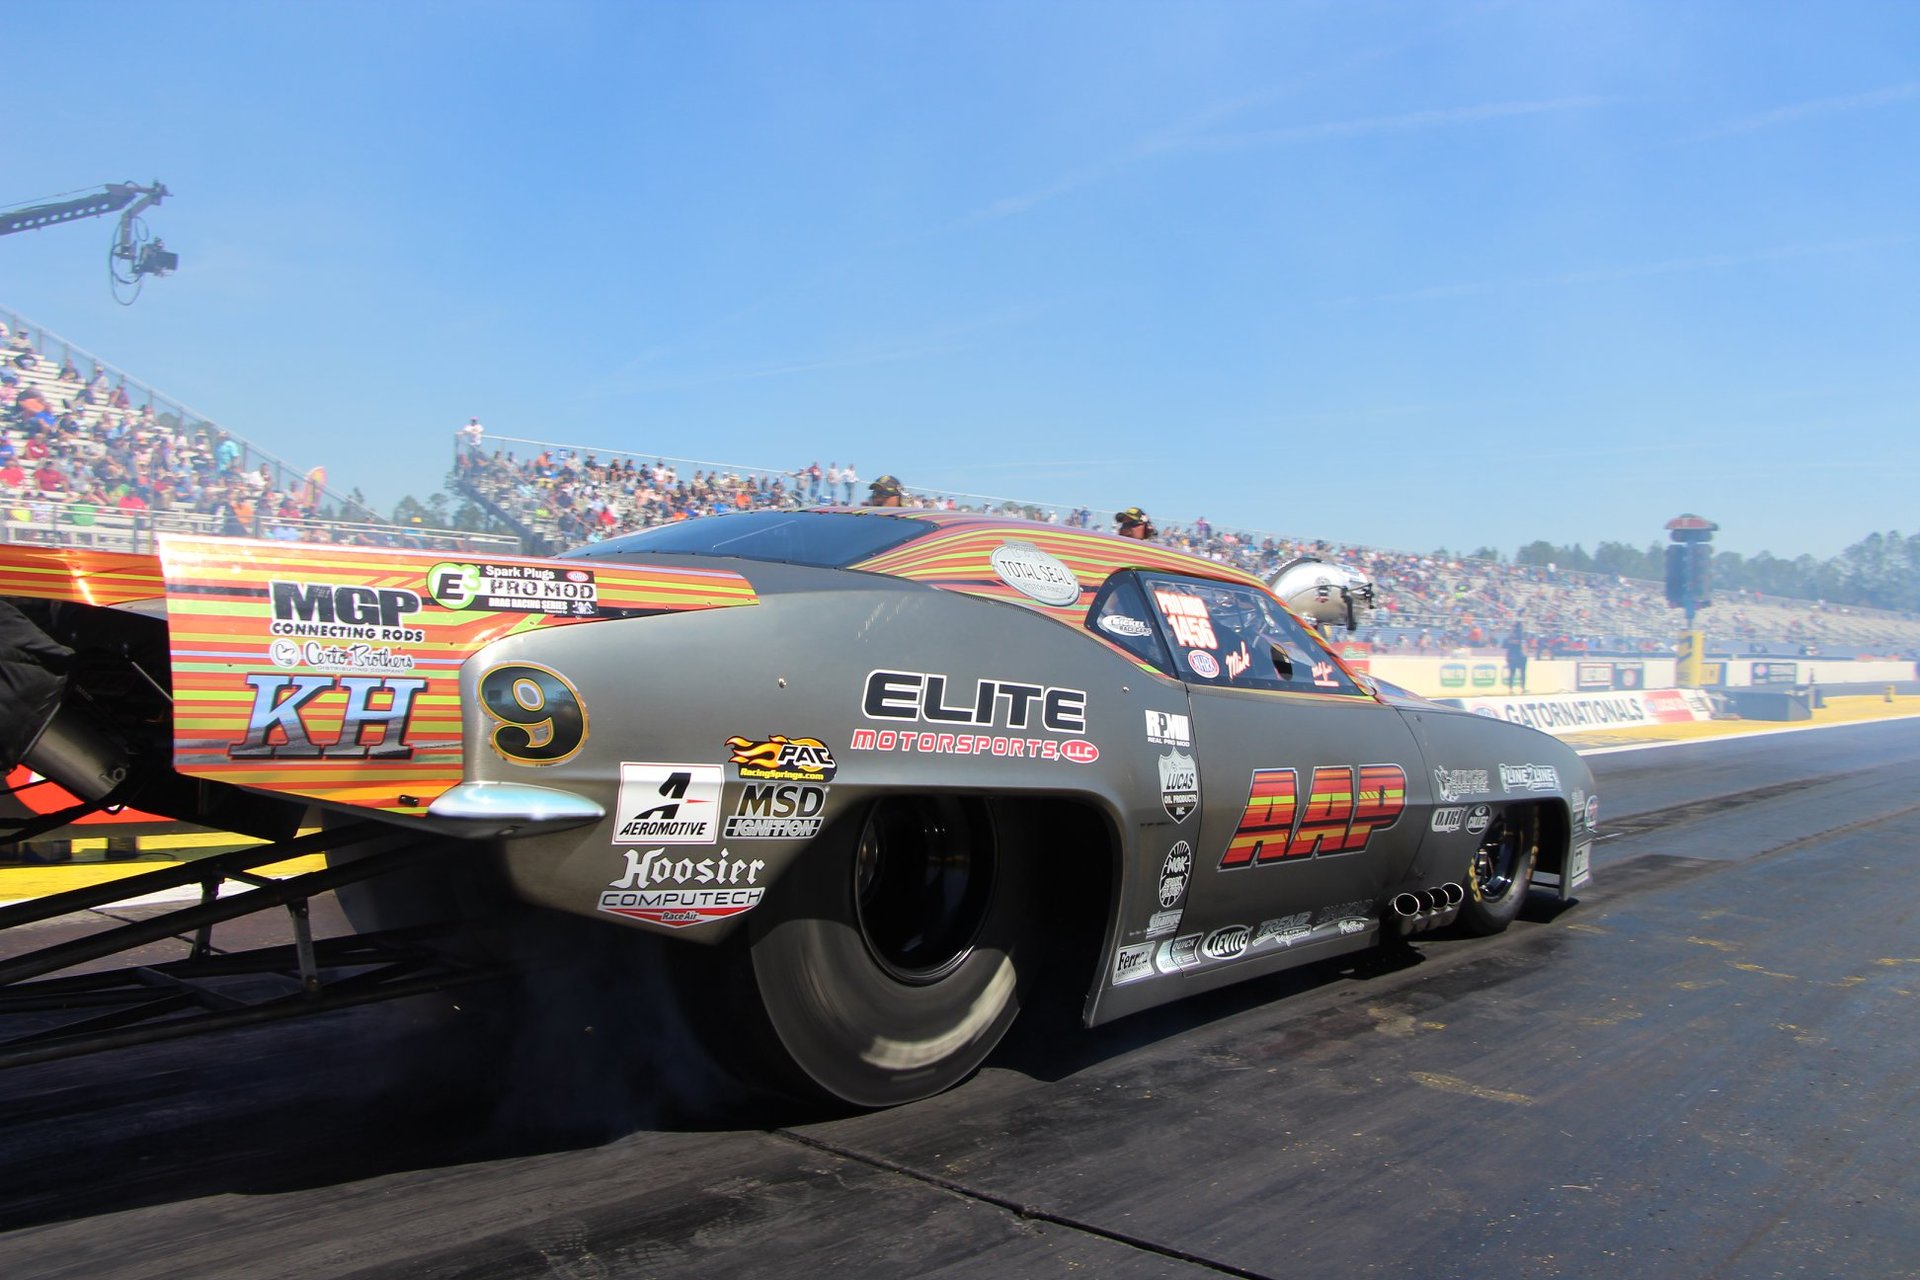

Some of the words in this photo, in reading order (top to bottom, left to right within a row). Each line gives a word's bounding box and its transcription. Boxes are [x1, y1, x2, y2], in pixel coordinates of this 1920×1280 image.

[485, 565, 521, 578] Spark
[523, 567, 556, 581] Plugs
[1000, 560, 1041, 580] TOTAL
[1040, 565, 1072, 585] SEAL
[489, 579, 538, 597] PRO
[543, 583, 594, 600] MOD
[271, 581, 420, 627] MGP
[488, 598, 511, 608] DRAG
[511, 600, 541, 610] RACING
[541, 601, 568, 611] SERIES
[272, 622, 376, 639] CONNECTING
[382, 628, 424, 642] RODS
[305, 641, 348, 666] Certo
[350, 644, 413, 669] Brothers
[861, 668, 1087, 735] ELITE
[228, 673, 430, 760] KH
[478, 665, 590, 762] 9
[1504, 698, 1645, 728] GATORNATIONALS
[1066, 744, 1093, 758] LLC
[1176, 740, 1190, 748] MOD
[776, 745, 835, 768] PAC
[740, 767, 824, 781] RacingSprings.com
[1166, 773, 1195, 790] LUCAS
[737, 784, 824, 818] MSD
[1164, 795, 1172, 804] OIL
[1173, 794, 1197, 803] PRODUCTS
[732, 818, 816, 837] IGNITION
[1217, 763, 1408, 872] AAP
[619, 821, 708, 836] AEROMOTIVE
[609, 847, 766, 889] Hoosier
[1166, 855, 1187, 874] NGK
[602, 891, 762, 907] COMPUTECH
[1172, 938, 1197, 951] QUICK
